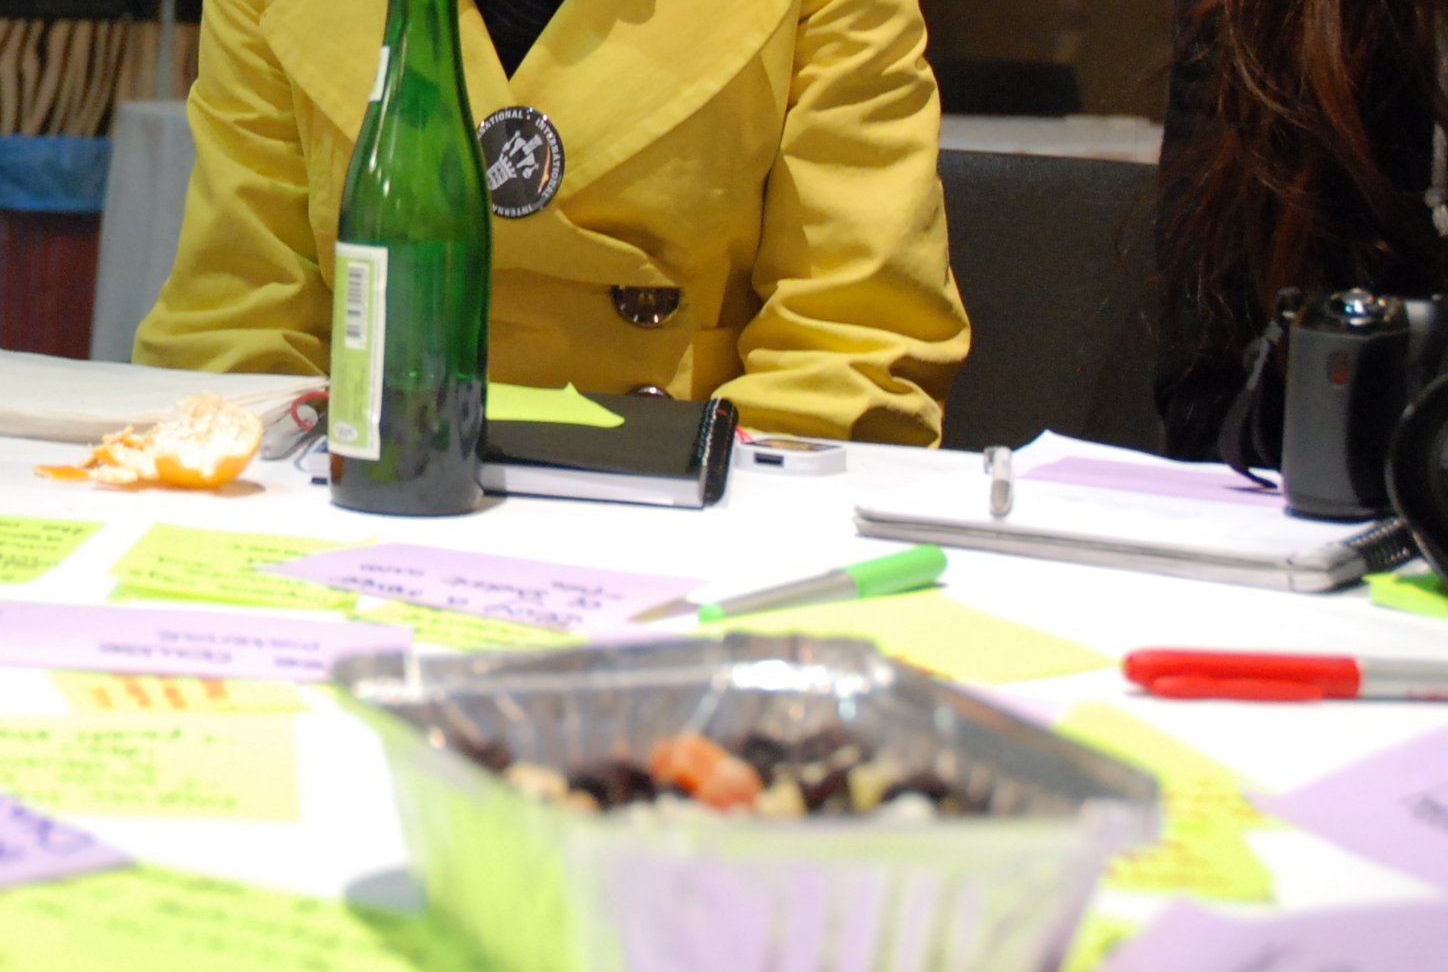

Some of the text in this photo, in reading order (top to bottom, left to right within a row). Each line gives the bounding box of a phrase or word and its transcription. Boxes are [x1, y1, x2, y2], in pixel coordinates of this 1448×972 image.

[477, 109, 524, 140] NATIONAL
[535, 117, 562, 199] INTERNATIONAL
[491, 203, 534, 218] INTERNA
